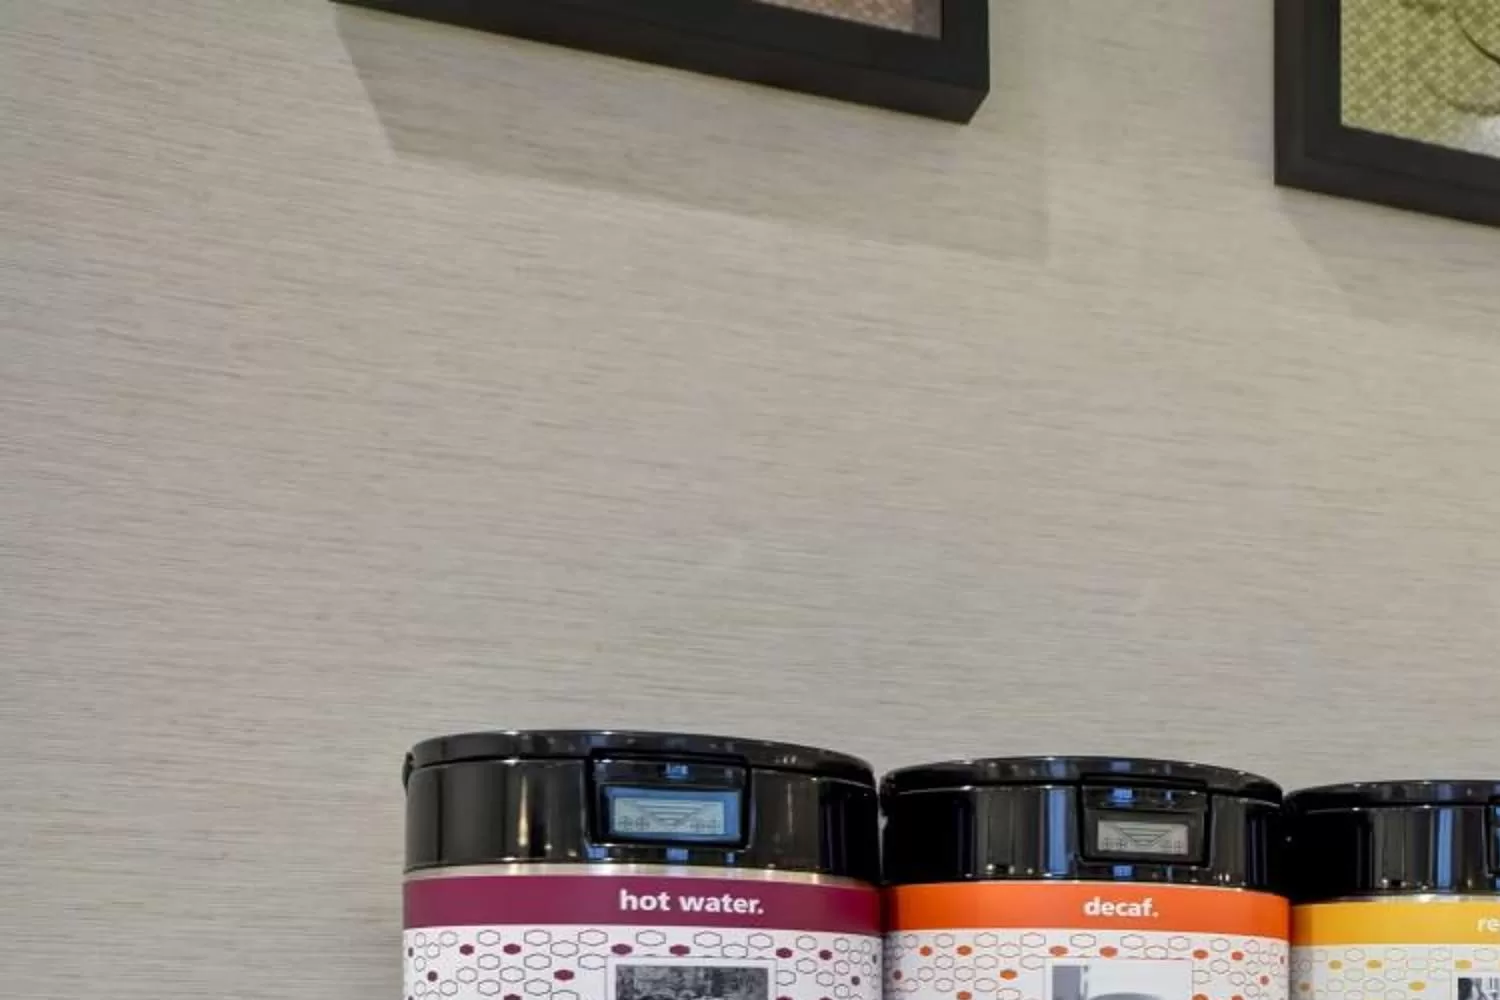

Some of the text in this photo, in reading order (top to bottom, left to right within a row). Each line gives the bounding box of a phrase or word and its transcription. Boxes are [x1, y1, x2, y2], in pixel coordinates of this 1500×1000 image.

[619, 888, 765, 915] hot water.
[1083, 896, 1159, 918] decaf.
